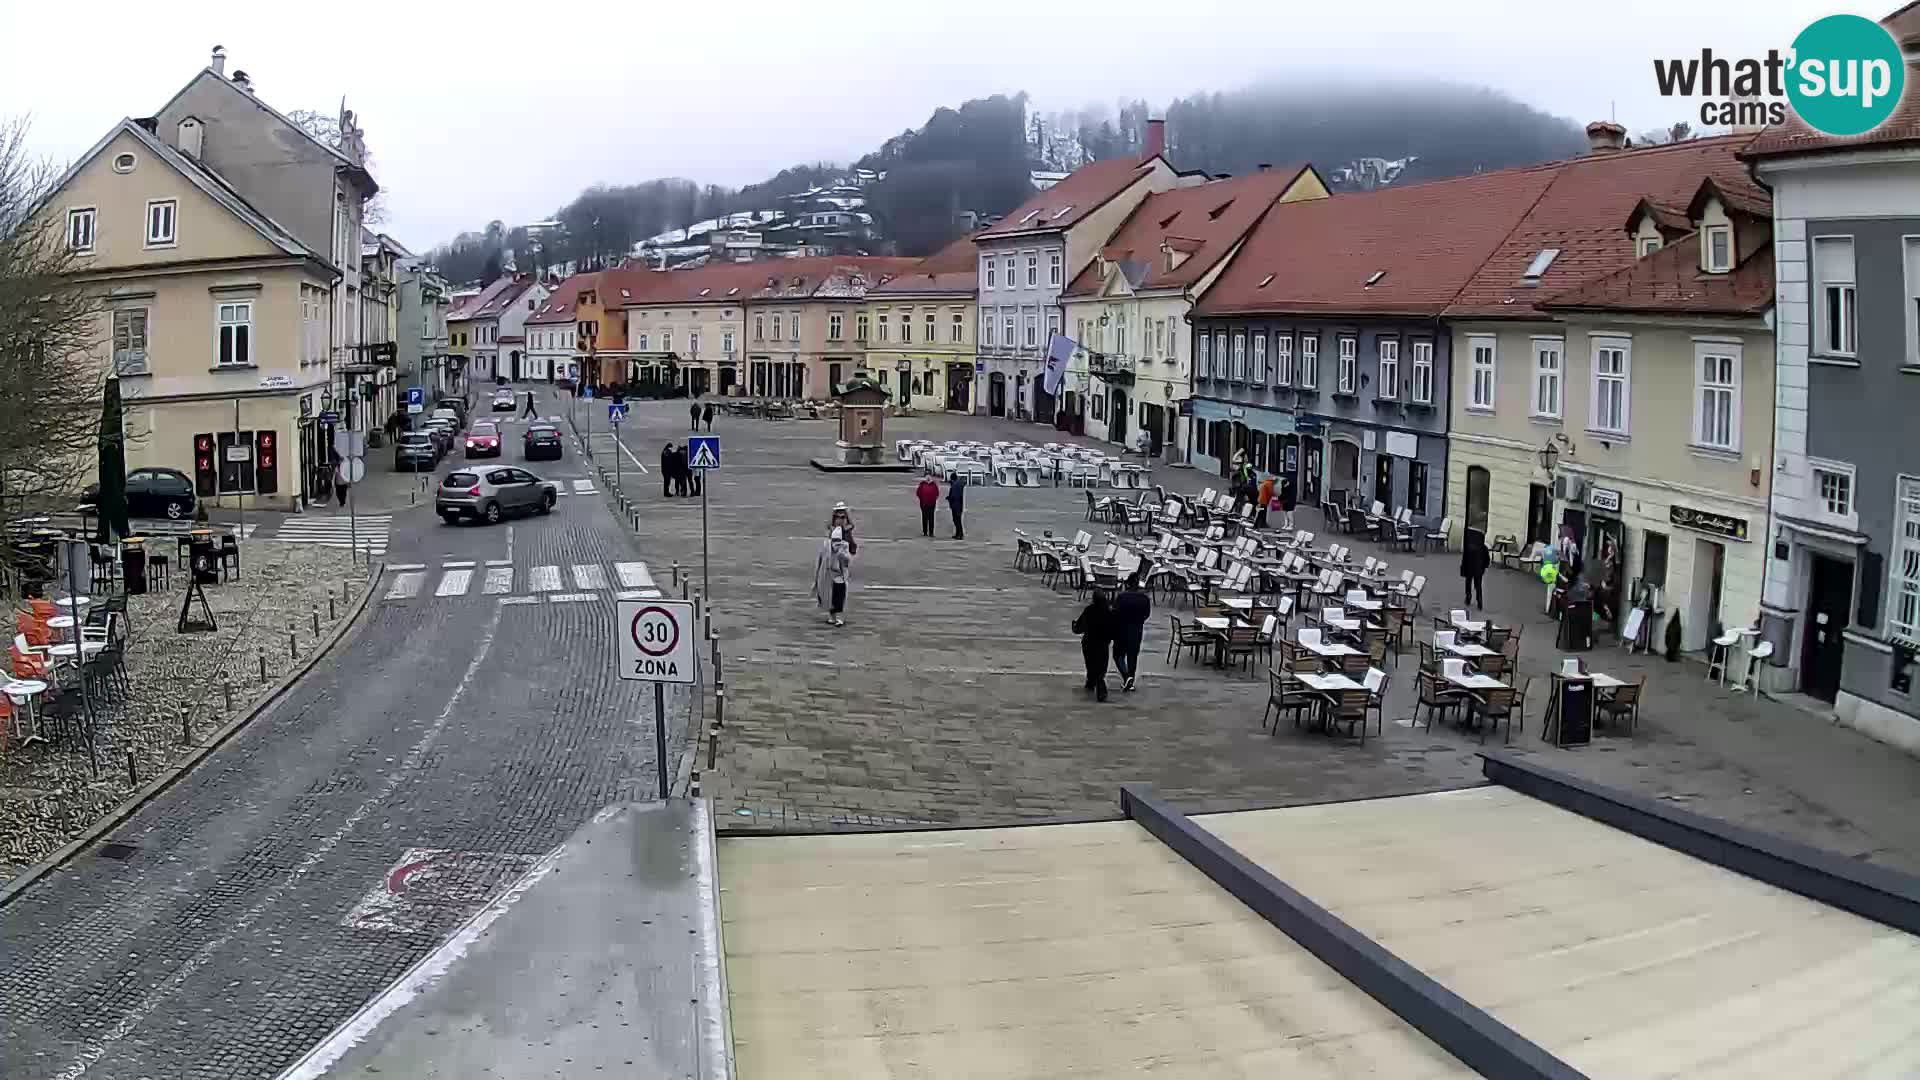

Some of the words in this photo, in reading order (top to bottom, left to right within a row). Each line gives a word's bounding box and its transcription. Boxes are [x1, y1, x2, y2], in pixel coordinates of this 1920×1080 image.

[411, 391, 420, 402] P
[643, 622, 668, 643] 30
[634, 660, 678, 677] ZONA
